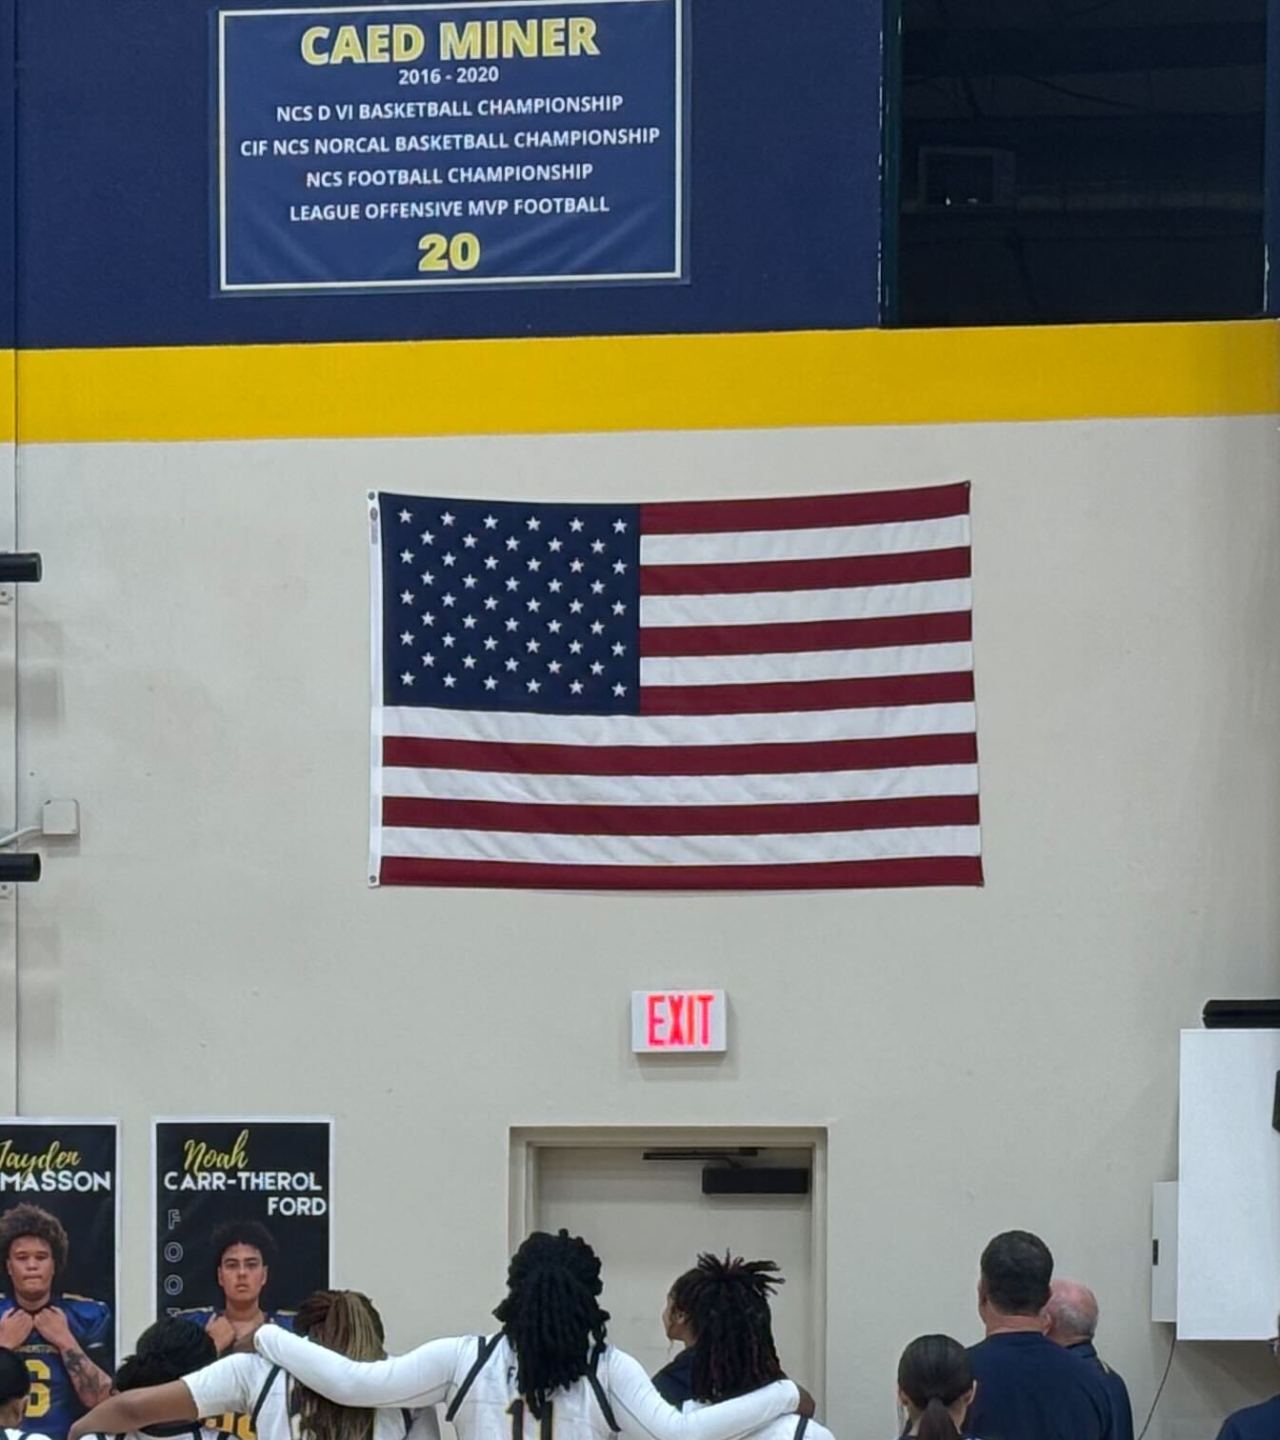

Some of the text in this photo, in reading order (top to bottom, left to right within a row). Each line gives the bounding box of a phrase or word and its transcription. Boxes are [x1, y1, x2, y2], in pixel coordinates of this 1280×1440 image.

[300, 17, 601, 66] CAED MINER
[398, 67, 441, 86] 2016
[456, 66, 499, 85] 2020
[276, 94, 624, 123] NCS D VI BASKETBALL CHAMPIONSHIP
[240, 127, 661, 157] CIF NCS NORCAL BASKETBALL CHAMPIONSHIP
[306, 163, 594, 189] NCS FOOTBALL CHAMPIONSHIP
[289, 195, 610, 222] LEAGUE OFFENSIVE MVP FOOTBALL
[417, 232, 481, 272] 20
[647, 995, 715, 1046] EXIT
[183, 1129, 250, 1172] Noah
[163, 1170, 323, 1192] CARR-THEROL
[267, 1196, 328, 1217] FORD
